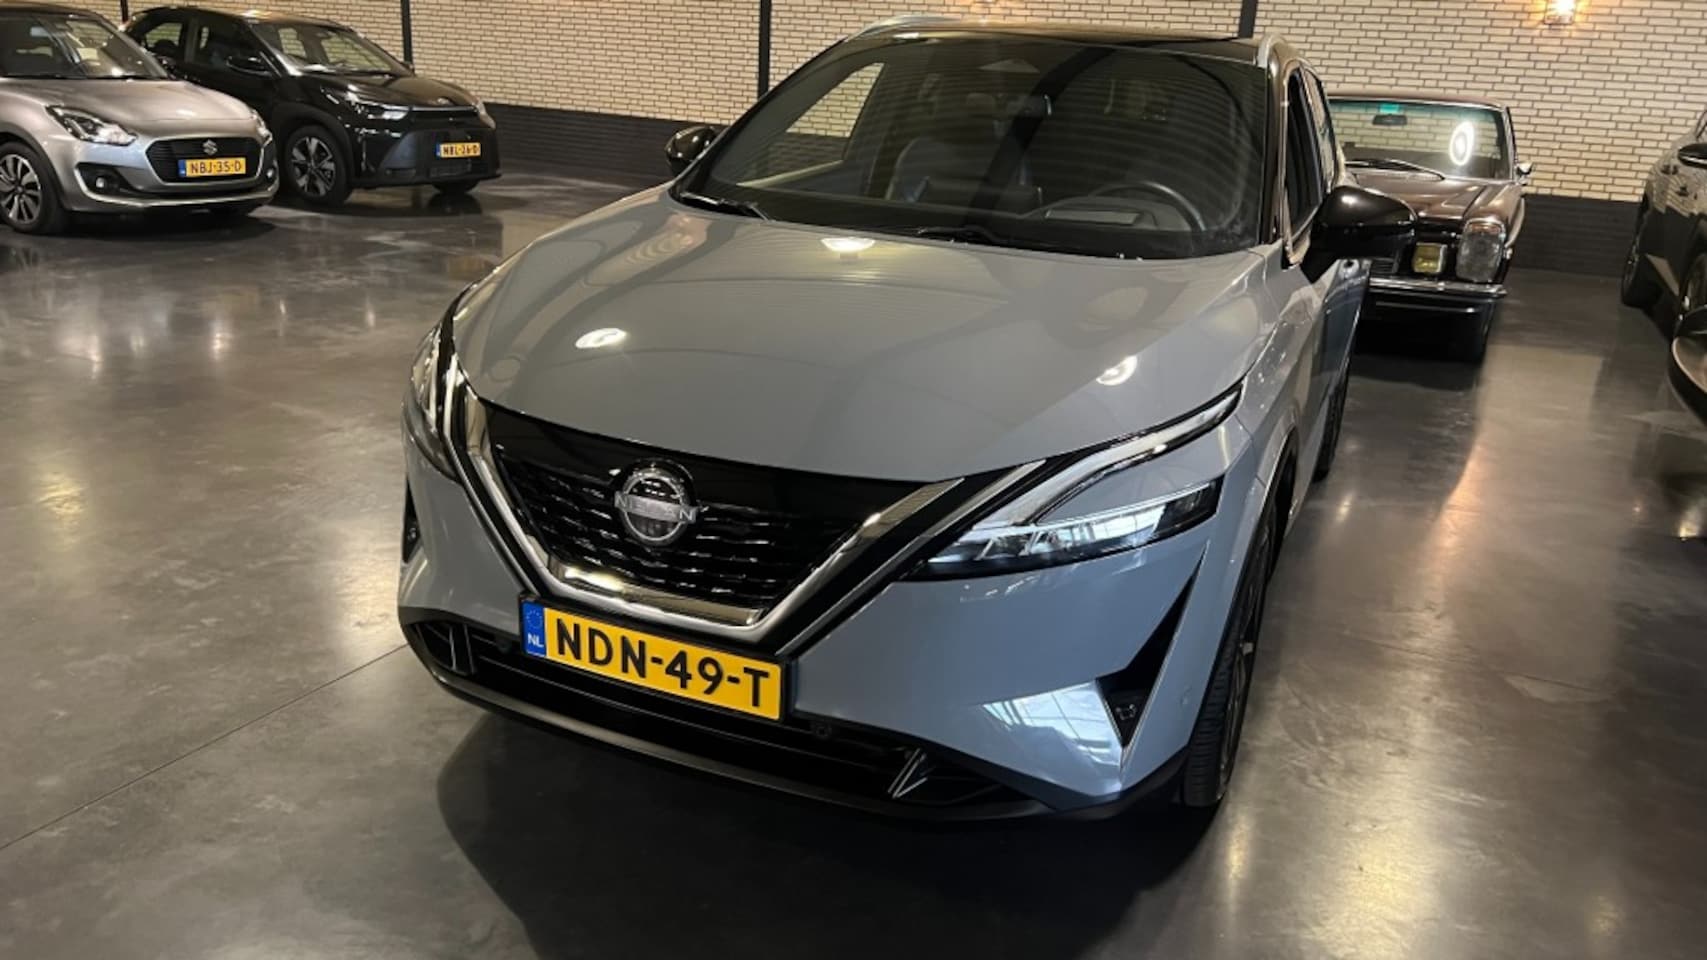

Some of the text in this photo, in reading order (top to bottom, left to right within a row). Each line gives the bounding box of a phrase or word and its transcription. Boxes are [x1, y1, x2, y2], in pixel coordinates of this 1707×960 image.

[614, 491, 698, 524] NISAN
[527, 633, 544, 648] NL
[556, 618, 770, 708] NDN-49-T
